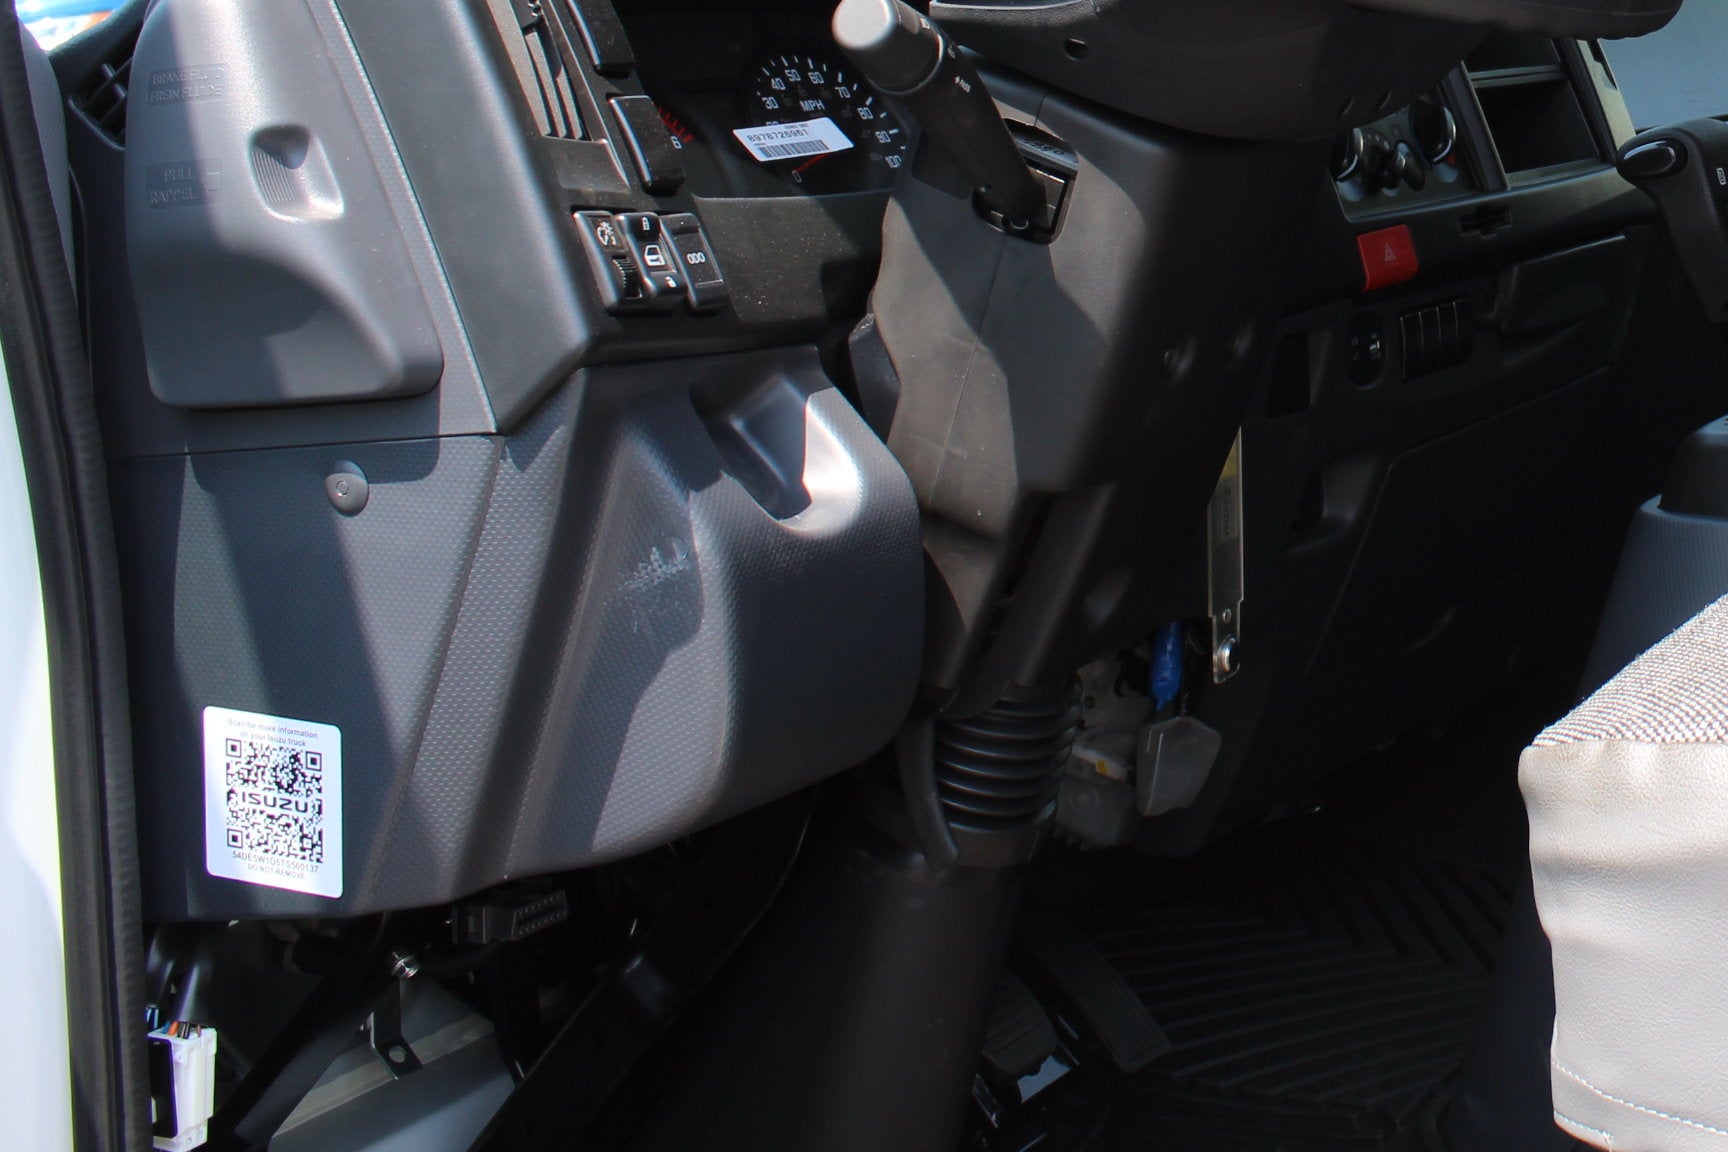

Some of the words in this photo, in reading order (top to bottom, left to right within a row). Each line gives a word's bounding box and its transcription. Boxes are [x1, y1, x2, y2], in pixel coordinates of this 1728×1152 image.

[152, 71, 187, 85] BRAKE
[190, 67, 225, 80] FLUID
[784, 69, 801, 82] 50
[808, 71, 825, 85] 60
[770, 77, 786, 91] 40
[150, 89, 180, 103] FREIN
[835, 86, 851, 99] 70
[762, 96, 779, 110] 30
[799, 99, 825, 112] MPH
[670, 135, 682, 149] 6
[875, 130, 892, 144] 90
[164, 167, 196, 183] PULL
[228, 718, 246, 727] Scan
[277, 726, 318, 739] information
[268, 734, 287, 744] Isuzu
[287, 737, 306, 747] truck
[241, 791, 309, 814] ISUZU
[248, 863, 259, 871] DO
[259, 865, 274, 874] NOT
[275, 867, 306, 880] REMOVE
